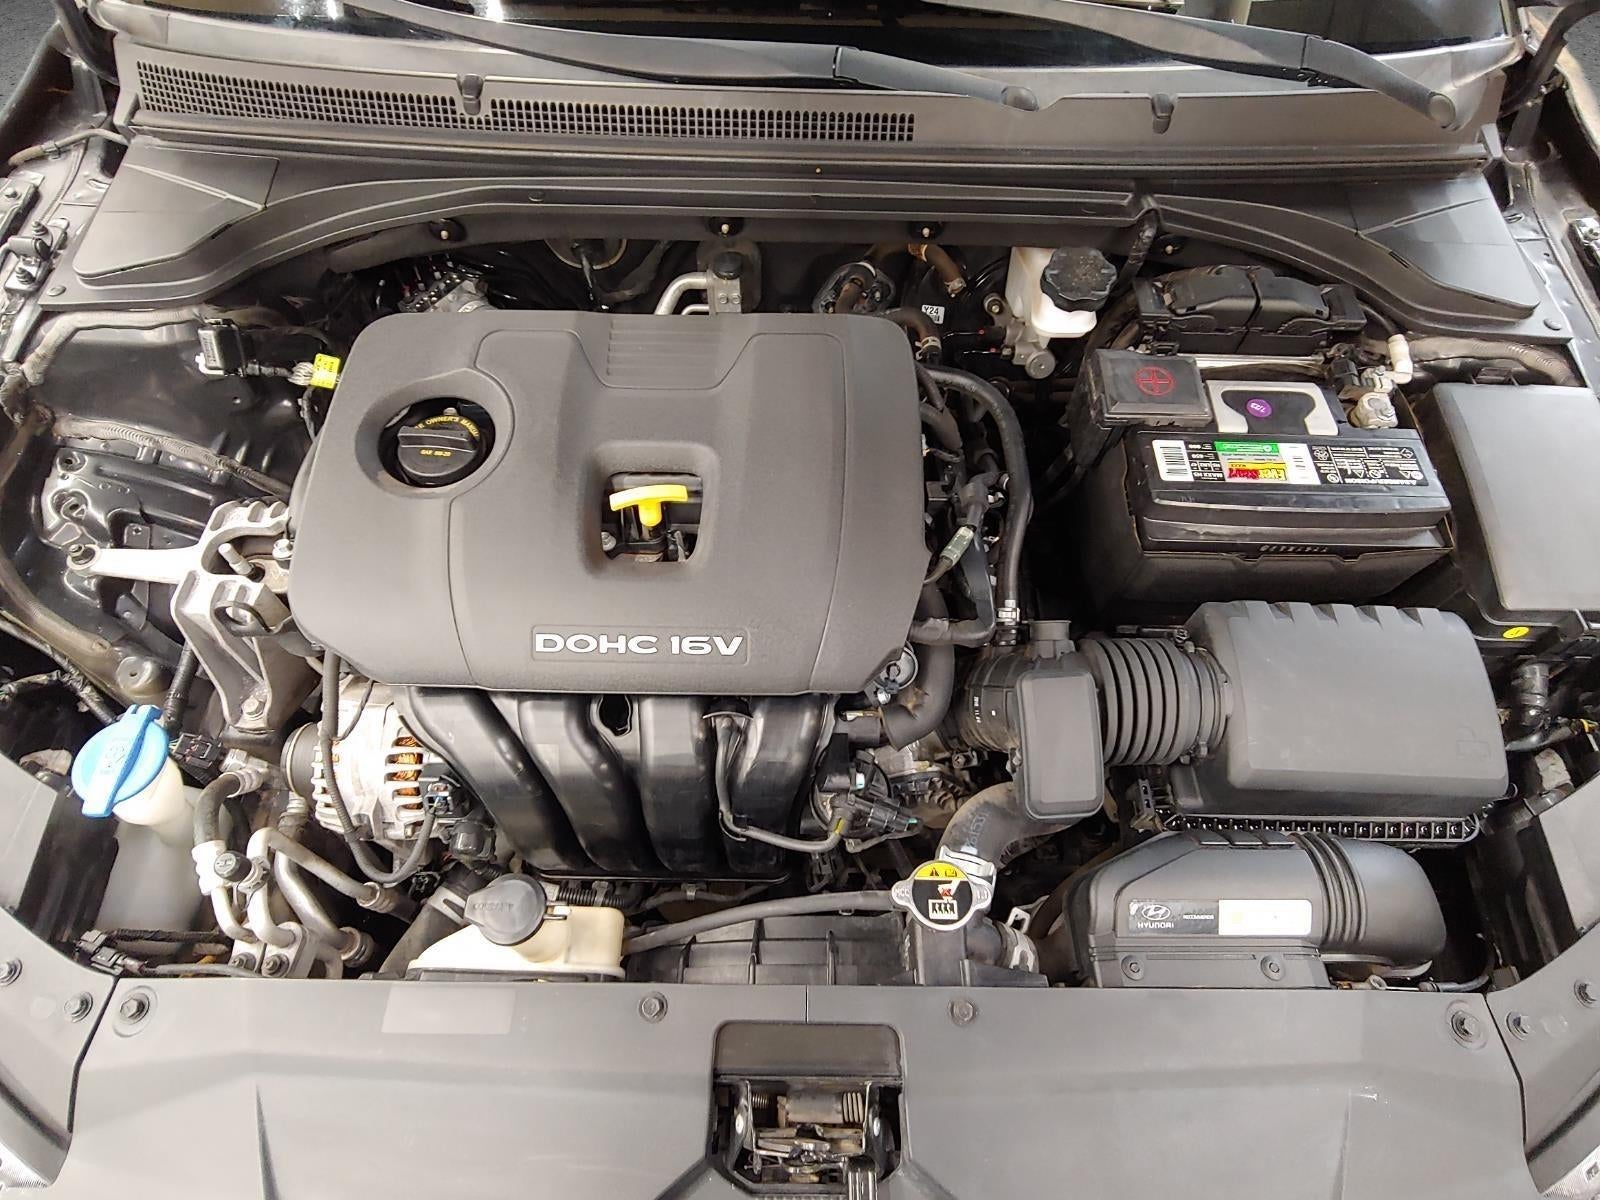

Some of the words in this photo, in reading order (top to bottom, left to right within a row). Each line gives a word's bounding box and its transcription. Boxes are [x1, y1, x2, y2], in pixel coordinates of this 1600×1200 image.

[535, 633, 658, 655] DOHC
[670, 635, 744, 656] 16V
[1137, 921, 1174, 929] HYUNDAI
